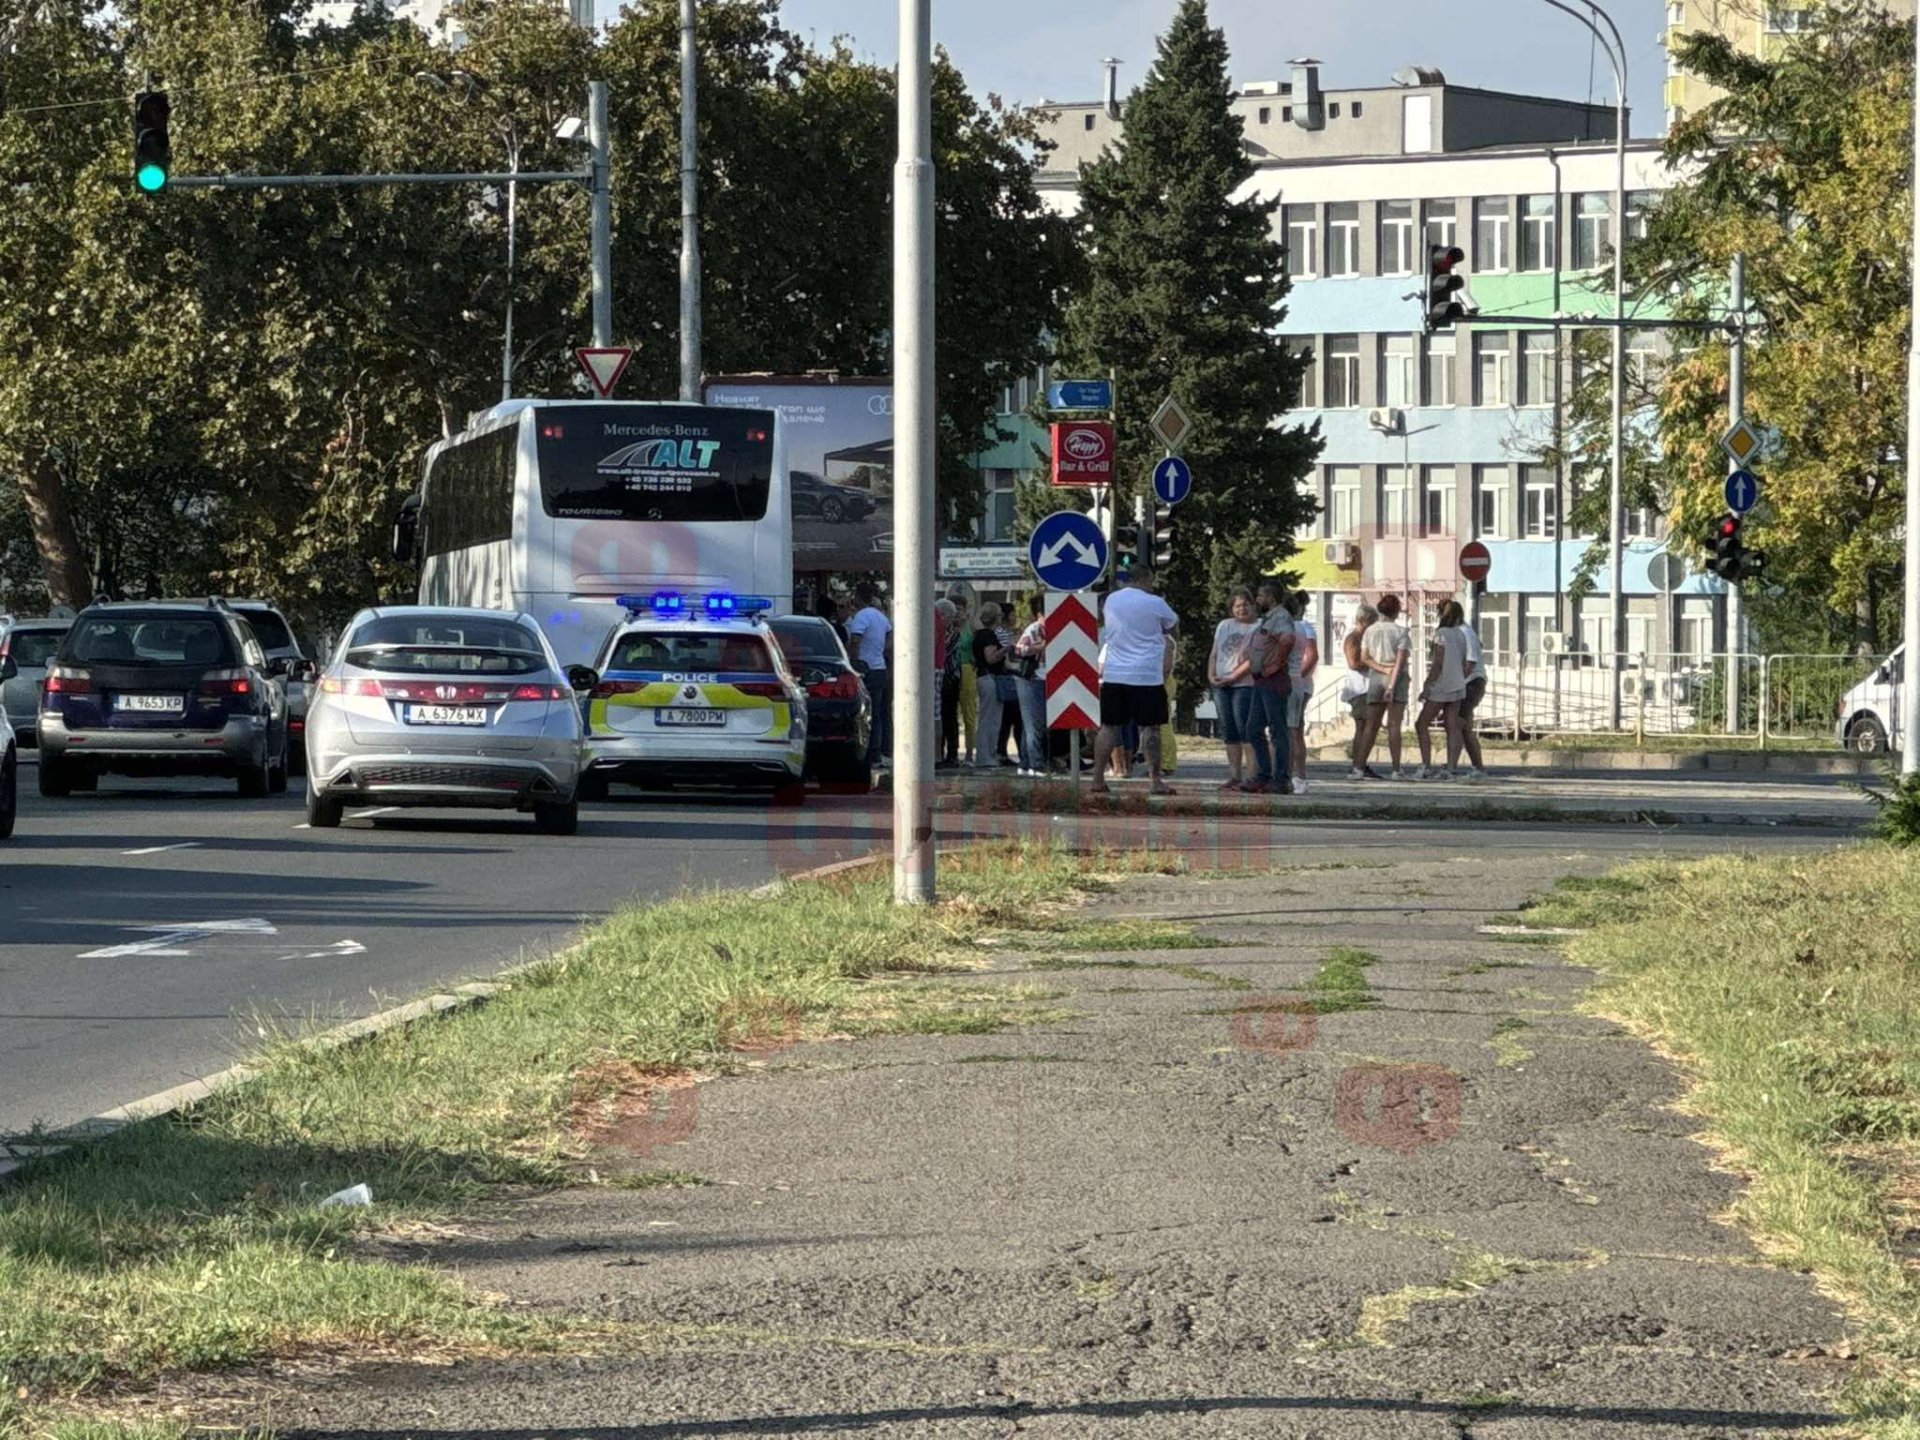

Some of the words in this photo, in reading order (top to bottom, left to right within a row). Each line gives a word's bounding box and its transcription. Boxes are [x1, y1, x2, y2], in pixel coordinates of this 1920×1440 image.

[603, 423, 709, 437] Mercedes-Benz
[651, 439, 721, 468] ALT
[1060, 461, 1076, 471] Bar
[1078, 461, 1086, 471] &
[1087, 461, 1109, 472] Grill
[558, 508, 623, 516] TOURISMO
[662, 673, 718, 683] POLICE
[418, 708, 426, 719] A
[433, 708, 464, 720] 6376
